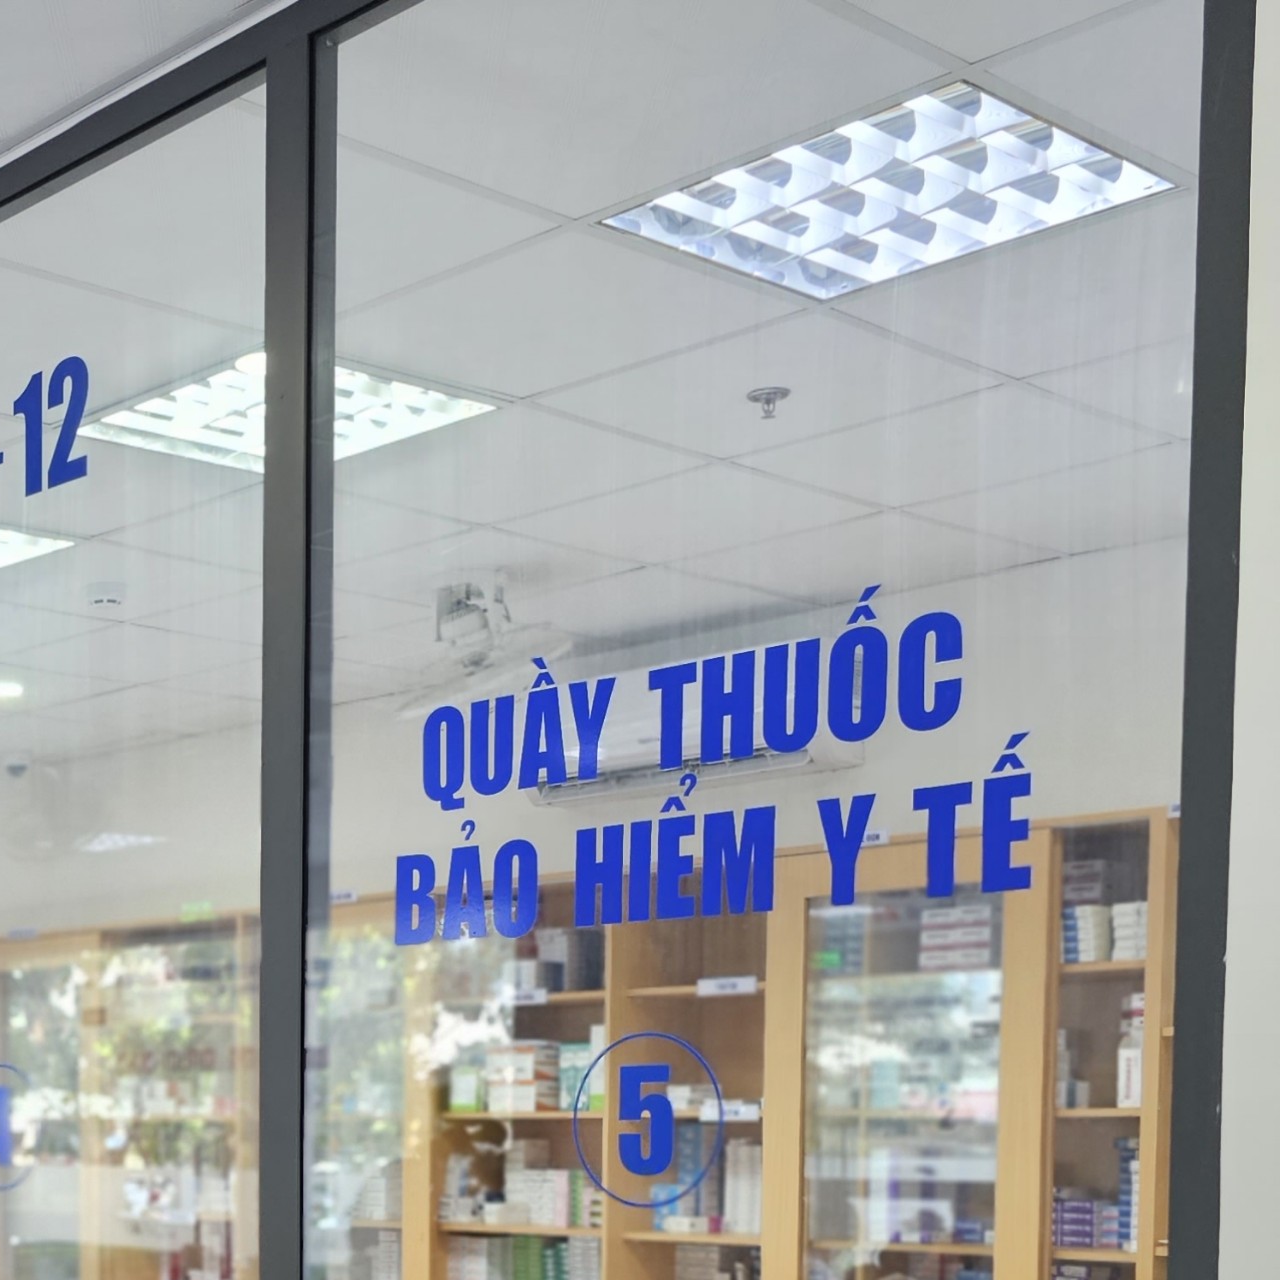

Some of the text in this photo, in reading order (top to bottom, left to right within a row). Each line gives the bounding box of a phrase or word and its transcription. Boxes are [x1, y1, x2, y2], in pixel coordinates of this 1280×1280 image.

[421, 583, 964, 812] QUẦY THUỐC
[394, 730, 1033, 946] BẢO HIỂM Y TẾ
[618, 1064, 675, 1176] 5
